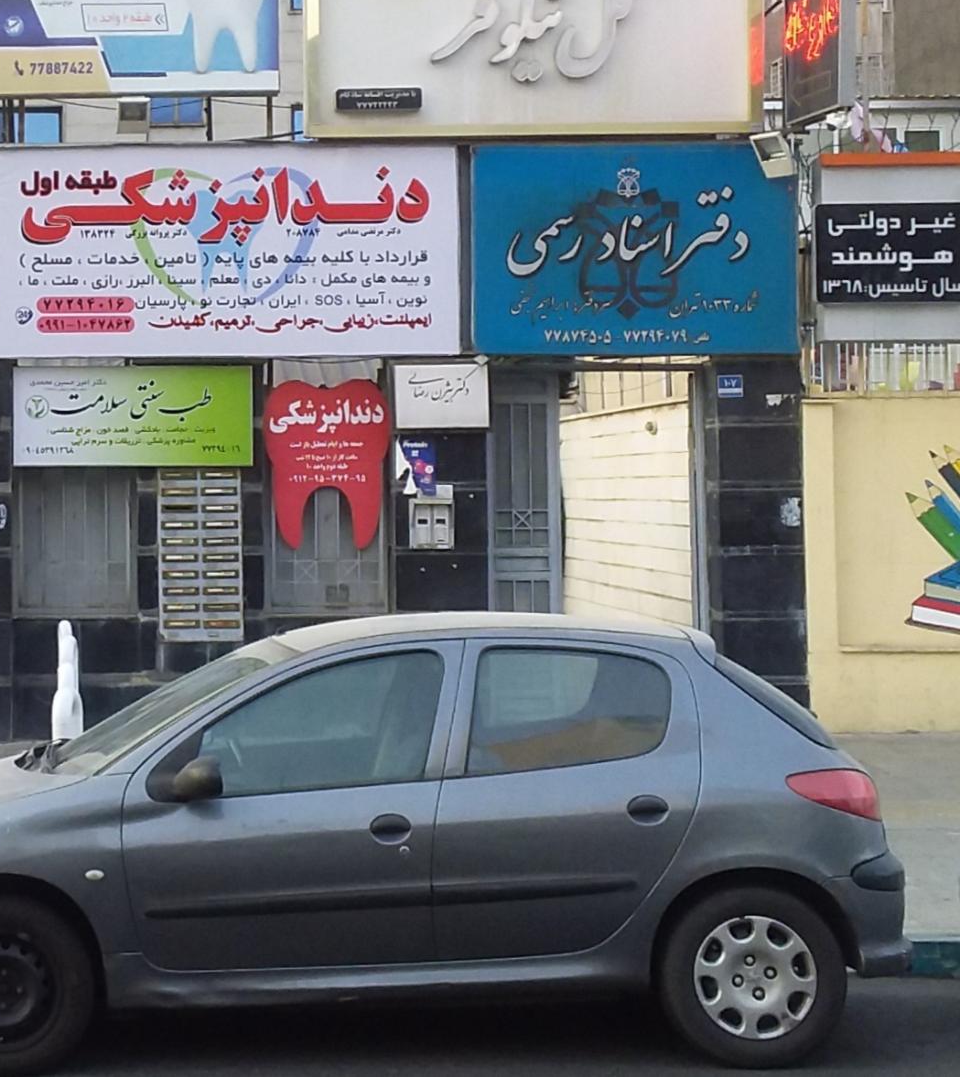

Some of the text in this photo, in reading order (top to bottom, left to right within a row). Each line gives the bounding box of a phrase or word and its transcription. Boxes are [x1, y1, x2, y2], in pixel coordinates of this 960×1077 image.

[29, 62, 93, 75] 77887422
[21, 171, 117, 196] طبقه اول
[20, 164, 430, 246] دندانپزشکی
[506, 185, 750, 277] دفتر اسناد رسمی
[827, 210, 956, 237] غیر دولتی
[215, 253, 244, 269] پایه
[249, 252, 278, 268] های
[283, 254, 316, 266] بیمه
[321, 250, 354, 265] کلیه
[359, 251, 370, 265] با
[375, 250, 428, 266] قرارداد
[832, 242, 953, 272] هوشمند
[361, 273, 387, 288] های
[390, 274, 419, 286] بیمه
[134, 295, 187, 310] پارسیان
[314, 295, 343, 305] SOS
[50, 392, 127, 415] سلامت
[158, 387, 212, 422] طب
[269, 398, 384, 435] دندانپزشکی
